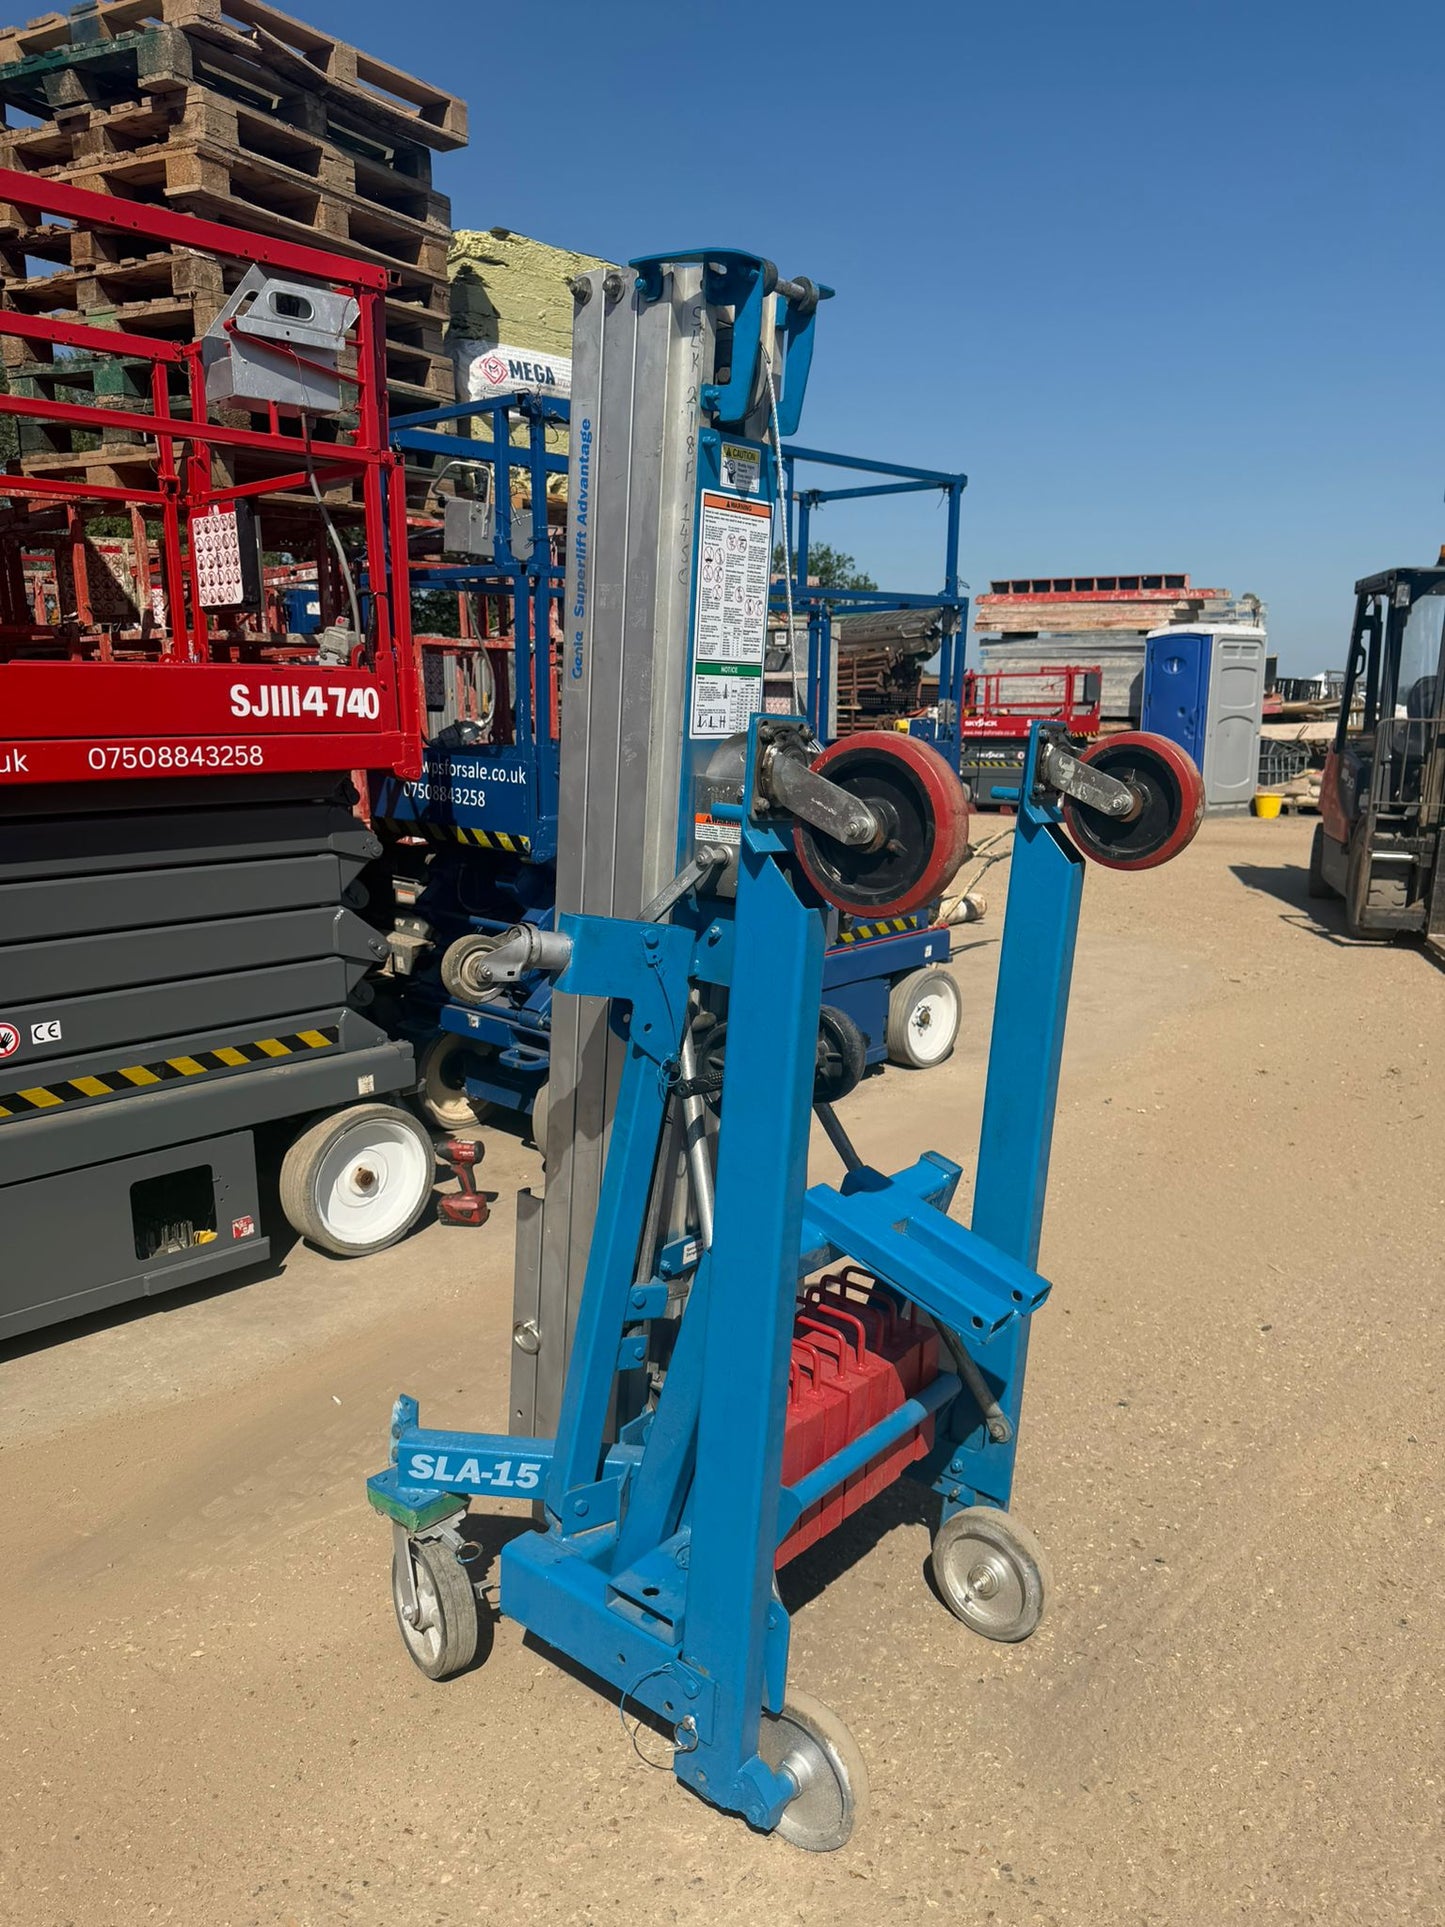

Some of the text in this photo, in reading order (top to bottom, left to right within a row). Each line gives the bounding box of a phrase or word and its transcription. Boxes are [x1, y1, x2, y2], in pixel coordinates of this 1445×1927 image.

[508, 359, 556, 386] MEGA
[732, 448, 757, 461] CAUTION
[571, 418, 593, 680] Genie Superlift Advantage
[720, 665, 739, 674] NOTICE
[88, 745, 264, 771] 07508843258
[403, 781, 486, 807] 07508843258
[33, 1022, 60, 1041] CE
[408, 1453, 542, 1489] SLA-15
